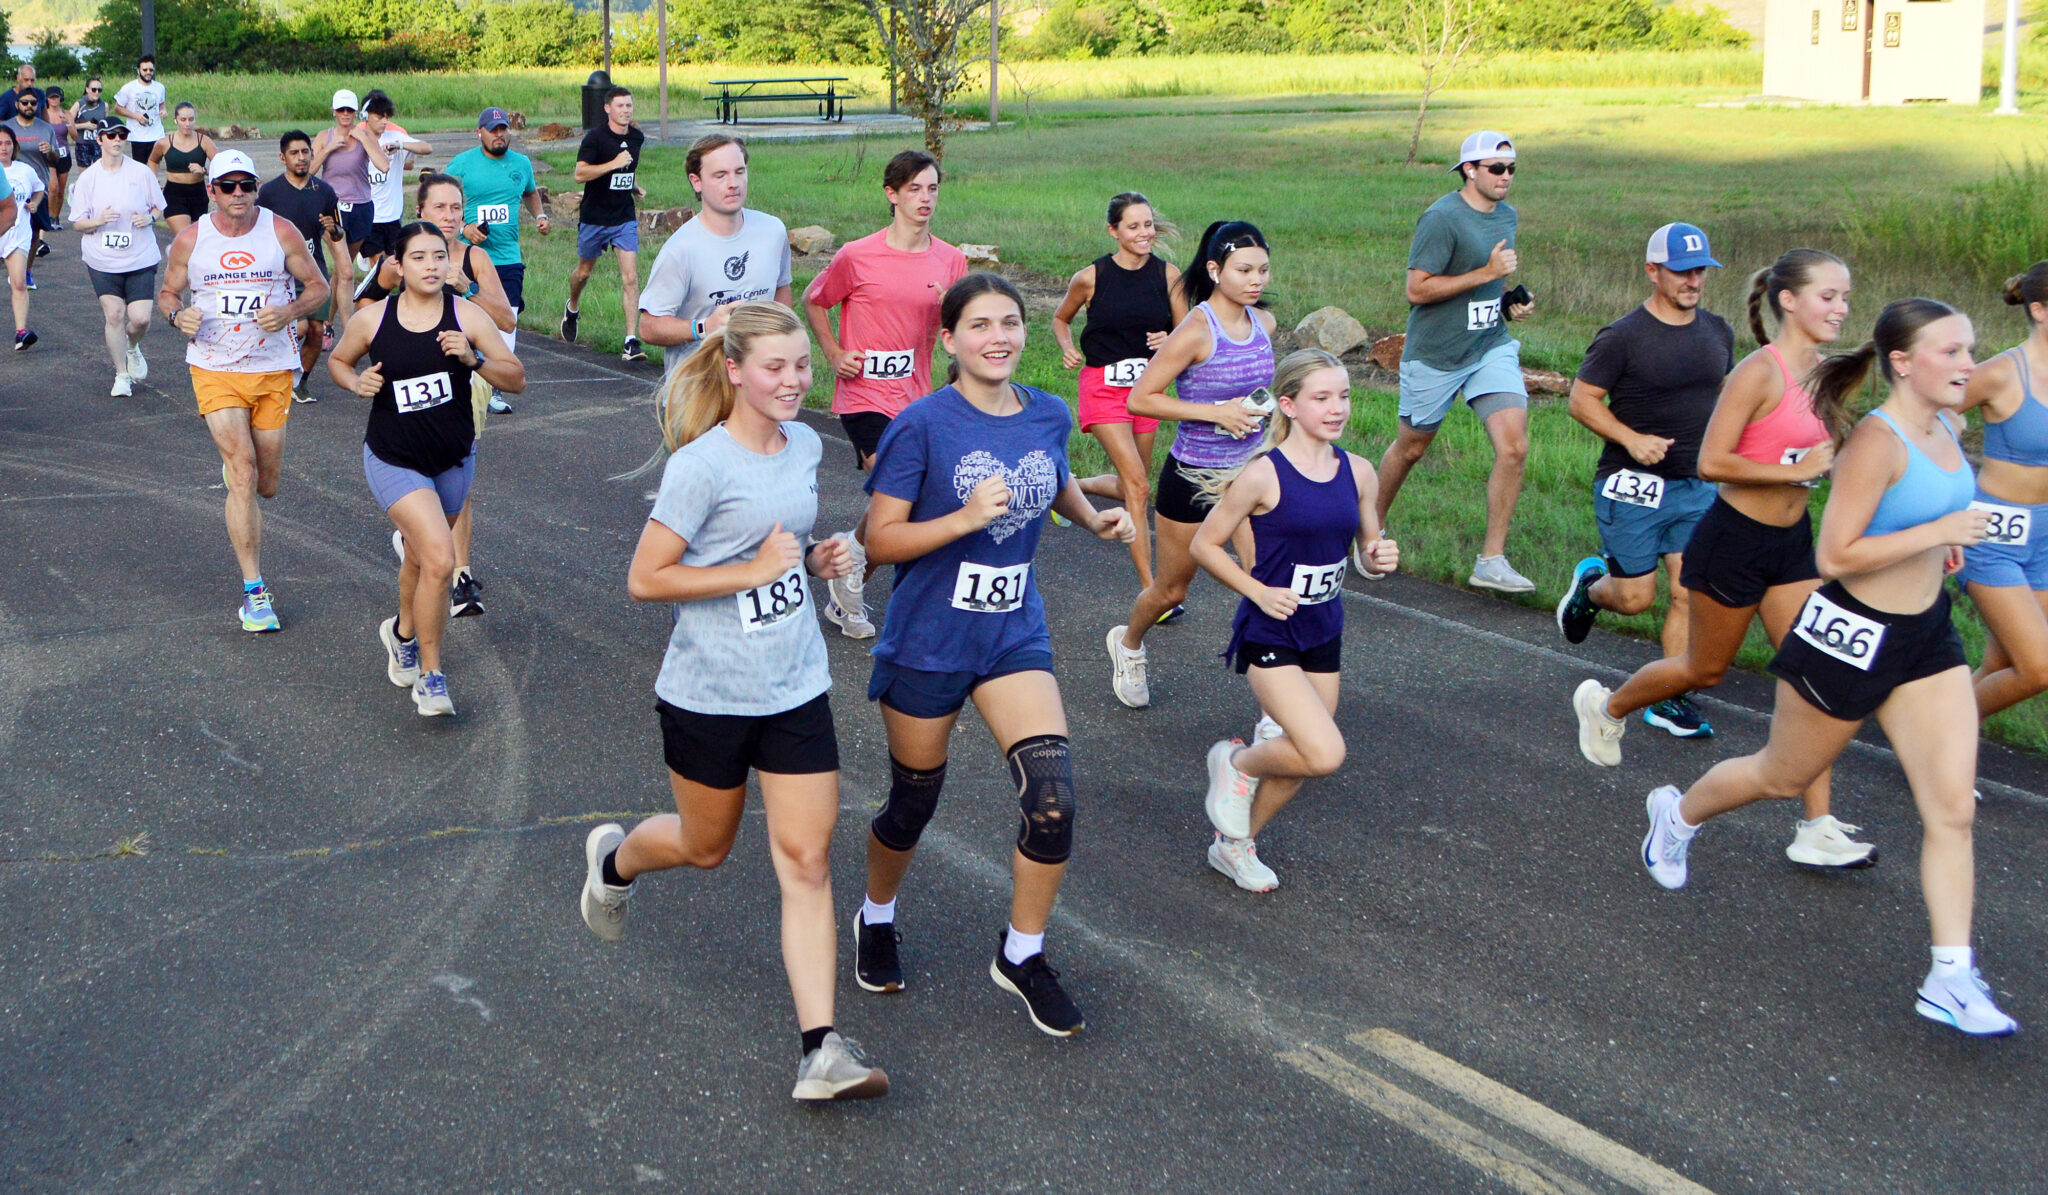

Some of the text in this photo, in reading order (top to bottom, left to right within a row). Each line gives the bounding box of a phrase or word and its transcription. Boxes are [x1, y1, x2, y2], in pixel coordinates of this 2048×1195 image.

[613, 175, 633, 188] 169
[480, 207, 508, 221] 108
[104, 234, 130, 248] 179
[1682, 234, 1703, 252] D
[203, 270, 273, 282] ORANGE MUD
[743, 287, 770, 300] Center
[221, 295, 263, 315] 174
[868, 355, 911, 376] 162
[401, 378, 449, 407] 131
[1608, 474, 1658, 502] 134
[1985, 512, 2025, 539] 36
[746, 573, 804, 623] 183
[961, 572, 1021, 606] 181
[1803, 605, 1875, 658] 166
[1032, 749, 1067, 759] copper
